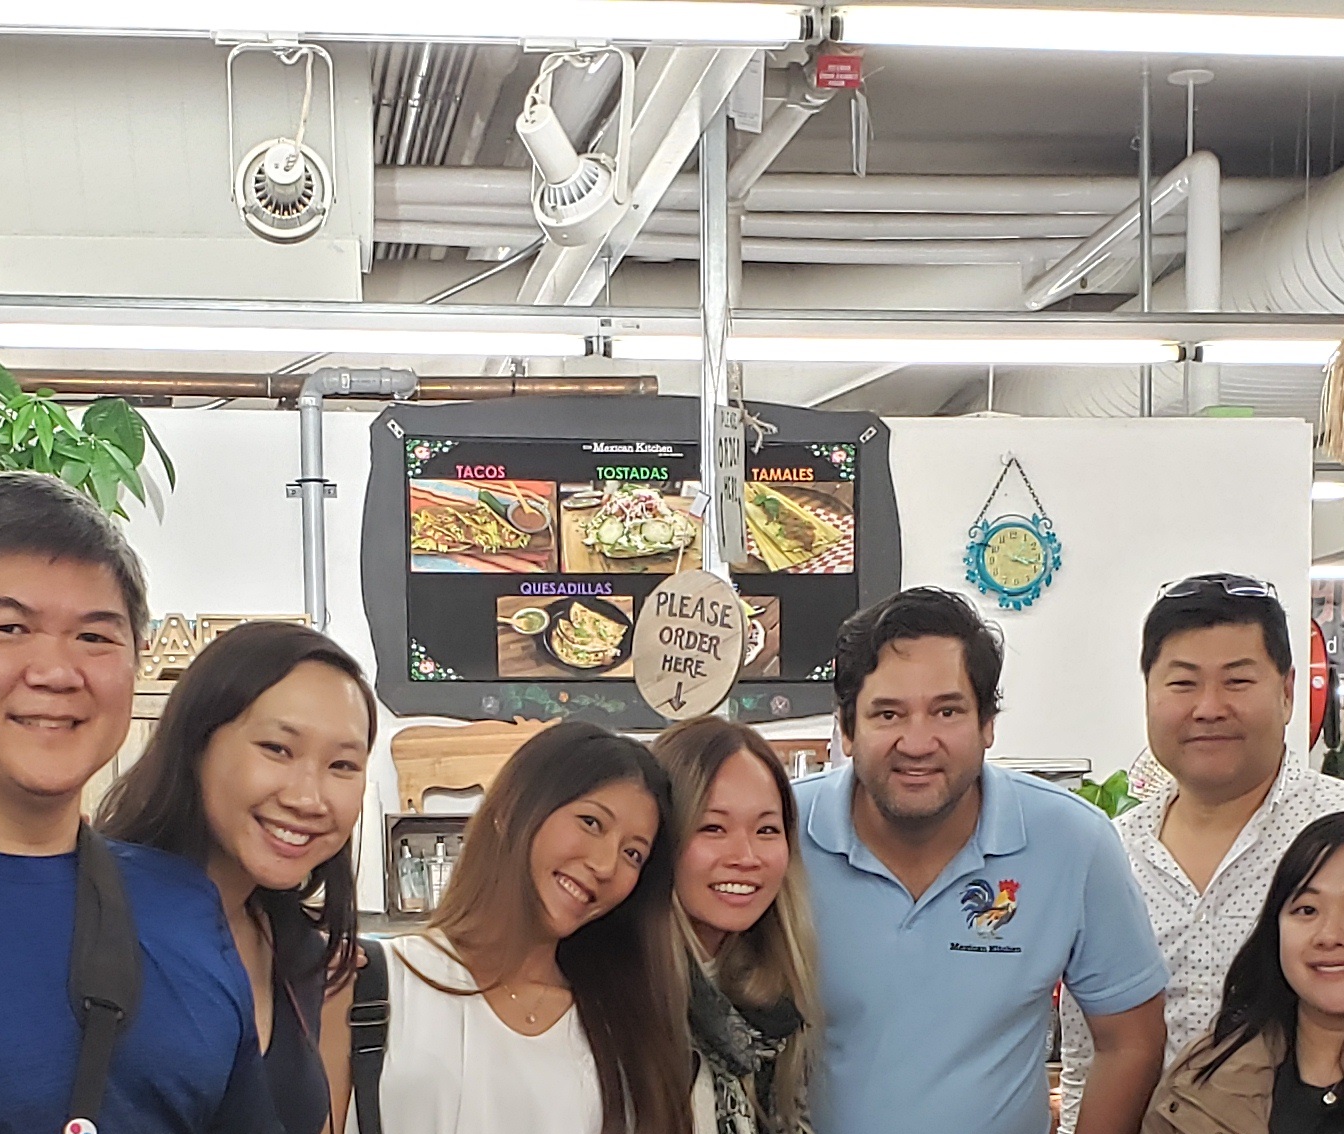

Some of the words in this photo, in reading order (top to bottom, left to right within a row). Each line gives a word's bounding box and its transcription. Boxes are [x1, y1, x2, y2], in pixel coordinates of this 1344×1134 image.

[592, 442, 634, 453] Mexican
[635, 442, 673, 453] Kitchen
[456, 464, 506, 480] TACOS
[596, 466, 669, 480] TOSTADAS
[751, 467, 814, 481] TAMALES
[520, 581, 613, 595] QUESADILLAS
[656, 591, 734, 630] PLEASE
[659, 625, 722, 661] ORDER
[661, 653, 707, 679] HERE
[950, 942, 988, 953] Mexican
[989, 945, 1022, 953] Kitchen
